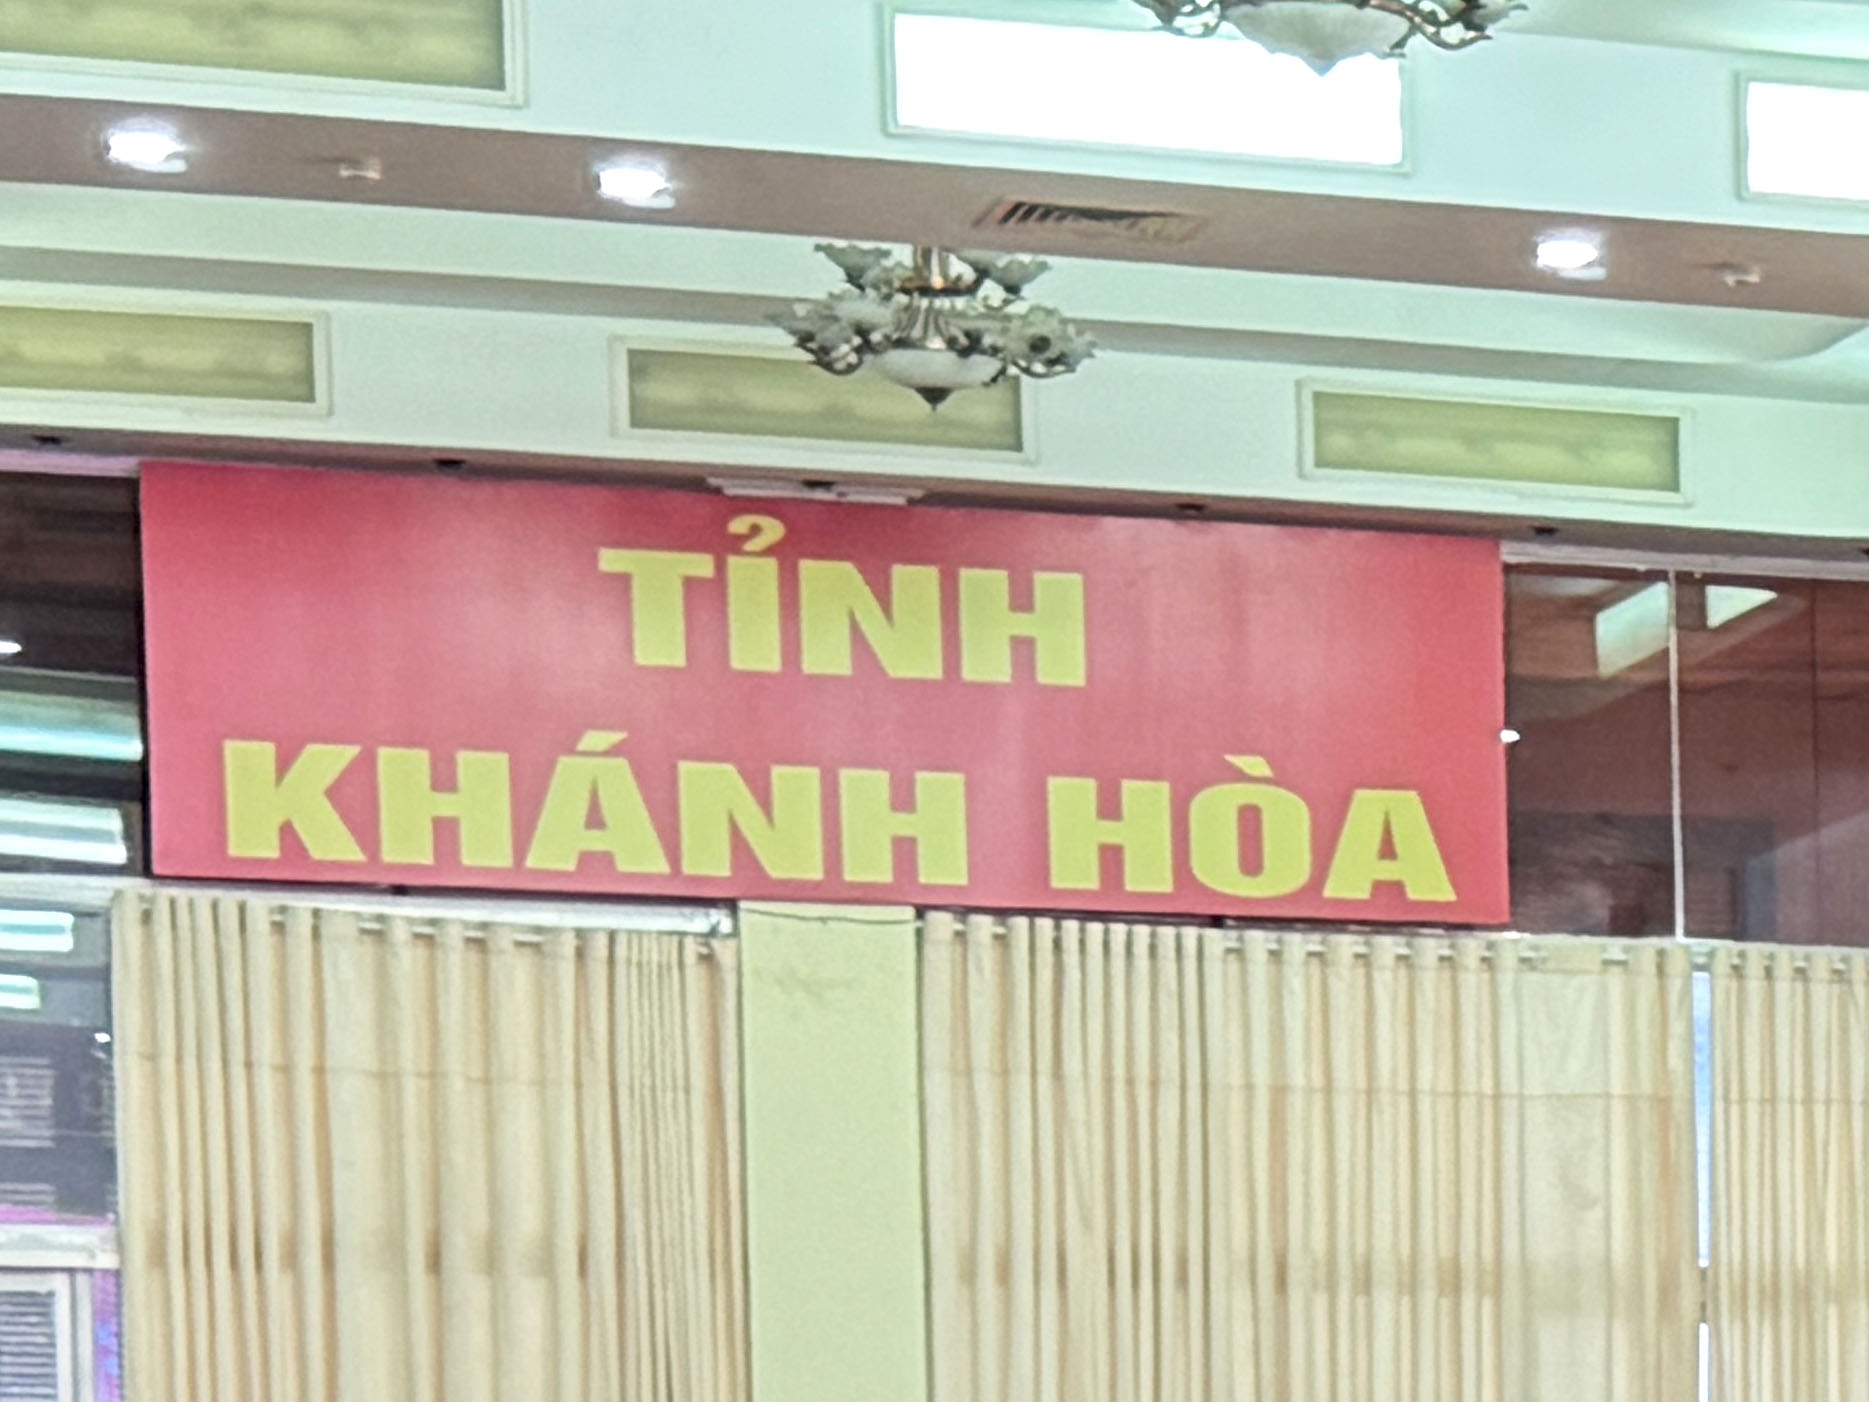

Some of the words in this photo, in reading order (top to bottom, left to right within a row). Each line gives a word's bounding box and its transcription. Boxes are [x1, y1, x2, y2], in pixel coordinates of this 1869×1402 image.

[600, 516, 1086, 687] TỈNH
[222, 730, 968, 887] KHÁNH
[1046, 755, 1458, 903] HÒA
